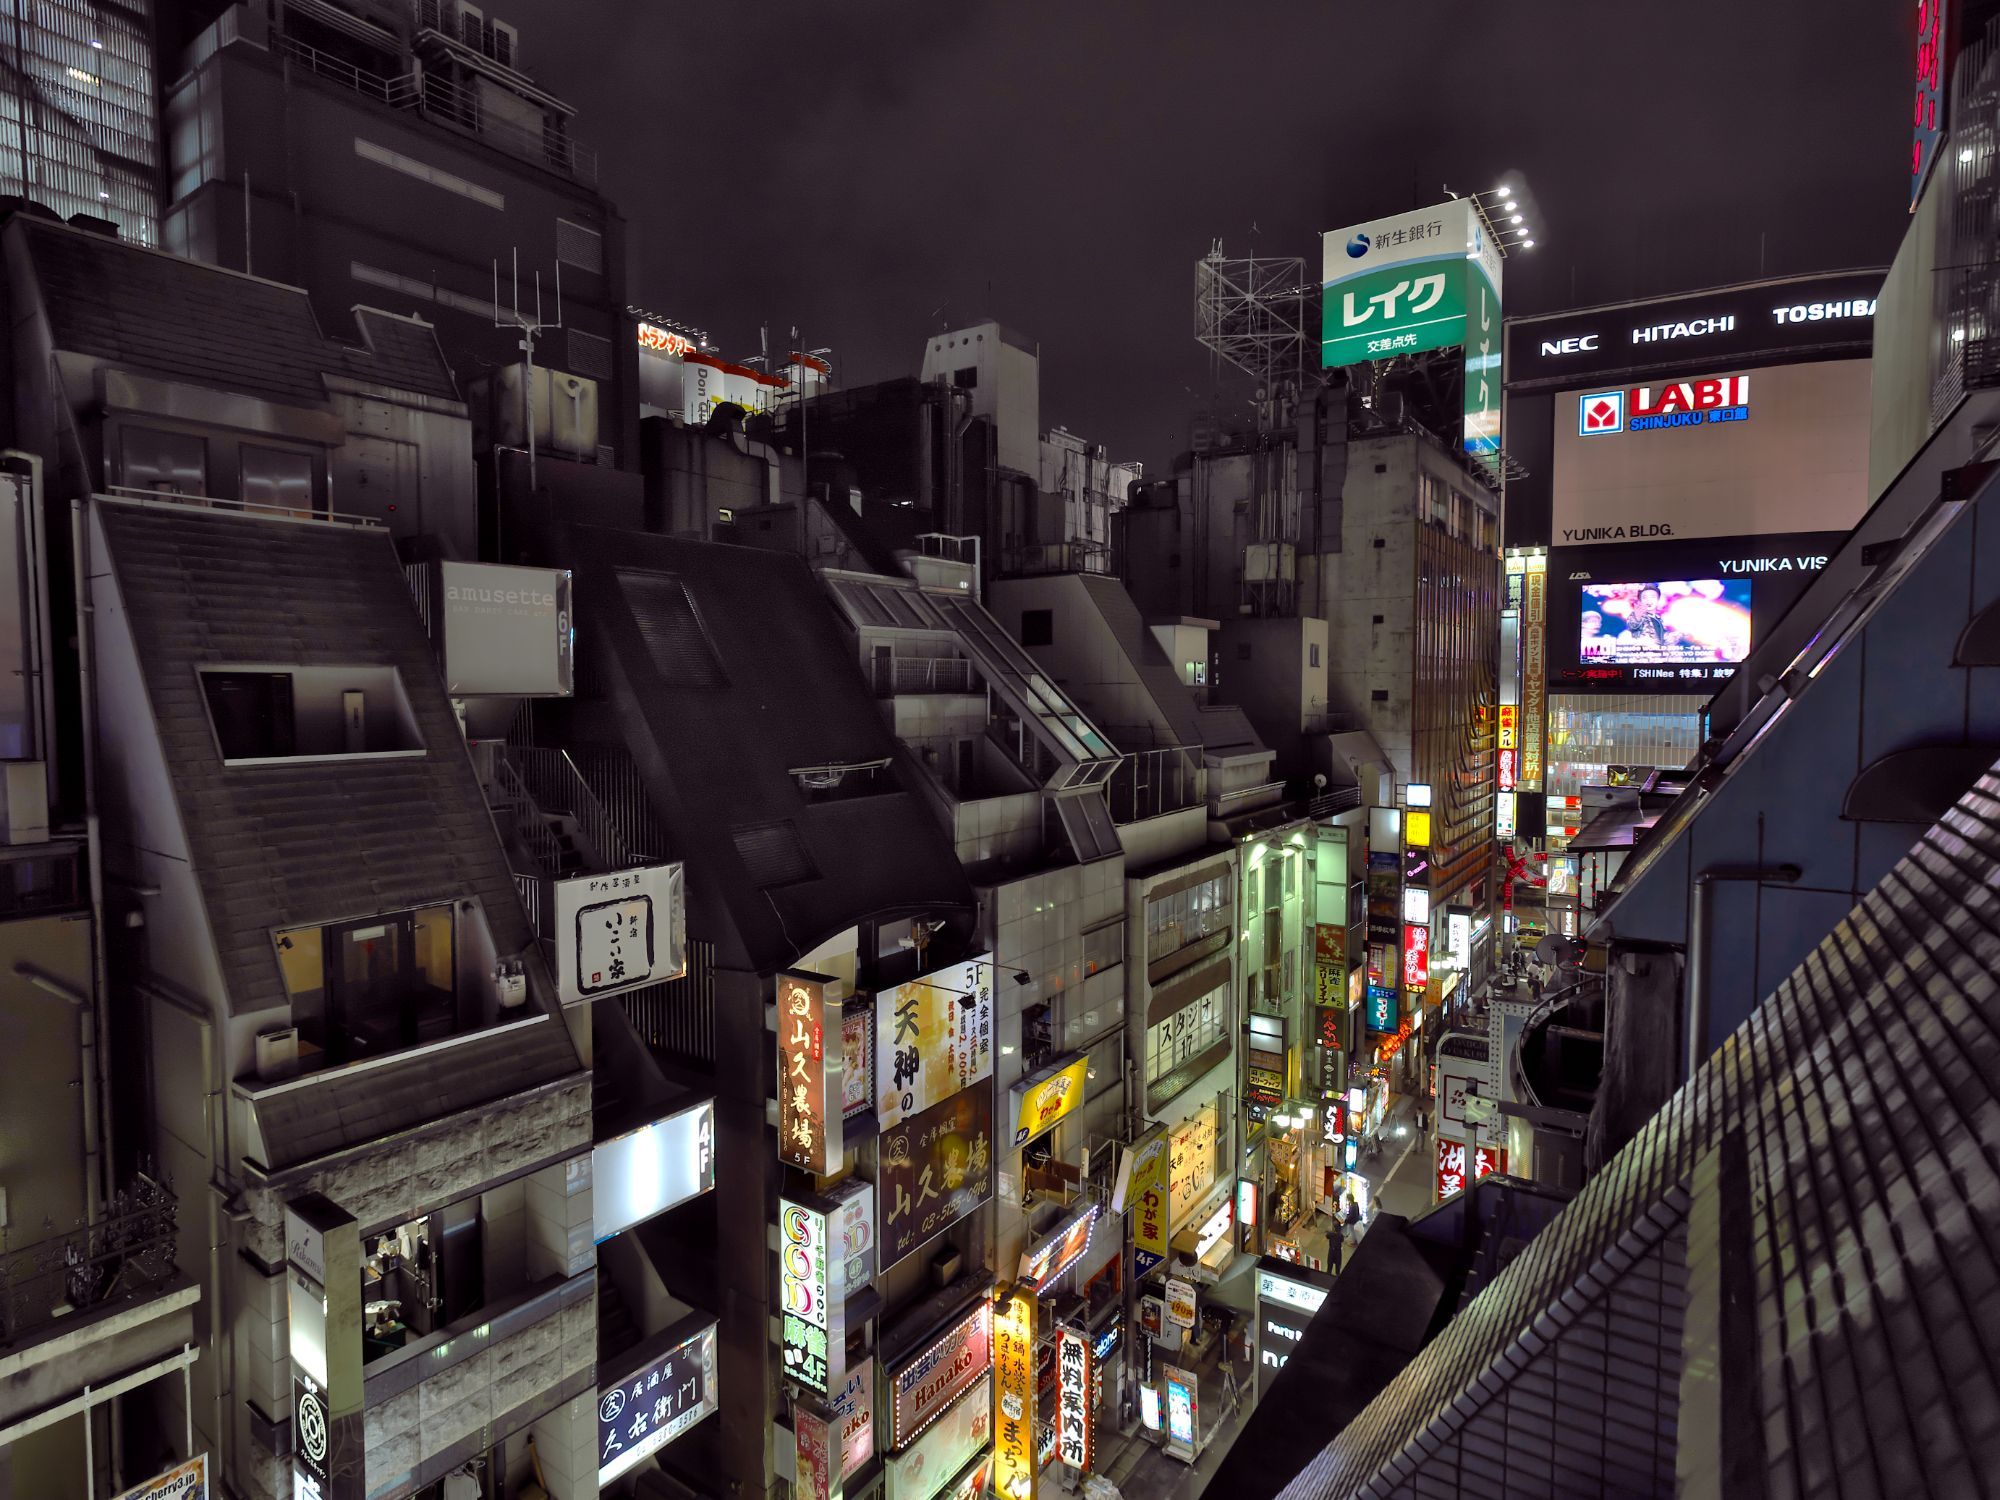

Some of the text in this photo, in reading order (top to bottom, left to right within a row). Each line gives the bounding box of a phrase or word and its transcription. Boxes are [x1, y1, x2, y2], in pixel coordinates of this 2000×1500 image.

[1375, 220, 1443, 249] 新生銀行
[1343, 273, 1446, 328] レイク
[1367, 333, 1418, 354] 交差点先
[1541, 334, 1600, 356] NEC
[1632, 315, 1735, 344] HITACHI
[697, 368, 708, 397] Don
[1629, 375, 1749, 417] LABI
[1629, 410, 1703, 431] SHINJUKU
[1562, 523, 1675, 542] YUNIKA BLDG.
[1719, 557, 1792, 573] YUNIKA
[447, 585, 555, 606] amusette
[558, 611, 568, 656] 6F
[629, 915, 639, 938] 新宿
[965, 963, 984, 989] 5F
[1404, 949, 1419, 983] 釜めし
[979, 987, 989, 1055] 完全個室
[1161, 998, 1211, 1047] スタジオ
[893, 999, 920, 1121] 天神の
[1181, 1034, 1193, 1061] 17
[790, 1019, 813, 1150] 山久農場
[1250, 1076, 1281, 1089] スリーファイブ
[699, 1121, 710, 1173] 4F
[794, 1152, 811, 1165] 5F
[887, 1130, 988, 1226] 山久農場
[1142, 1190, 1159, 1240] わが家
[784, 1206, 814, 1316] GOD
[1135, 1251, 1154, 1267] 4F
[683, 1346, 693, 1360] 3F
[784, 1315, 828, 1361] 麻雀
[902, 1316, 981, 1394] 出会いカフェ
[630, 1361, 674, 1401] 居酒屋
[803, 1354, 827, 1382] 4F
[914, 1350, 973, 1412] Hanako
[1013, 1358, 1026, 1397] 水炊き
[602, 1377, 697, 1460] 久右衛門
[1062, 1339, 1084, 1463] 無料案内所
